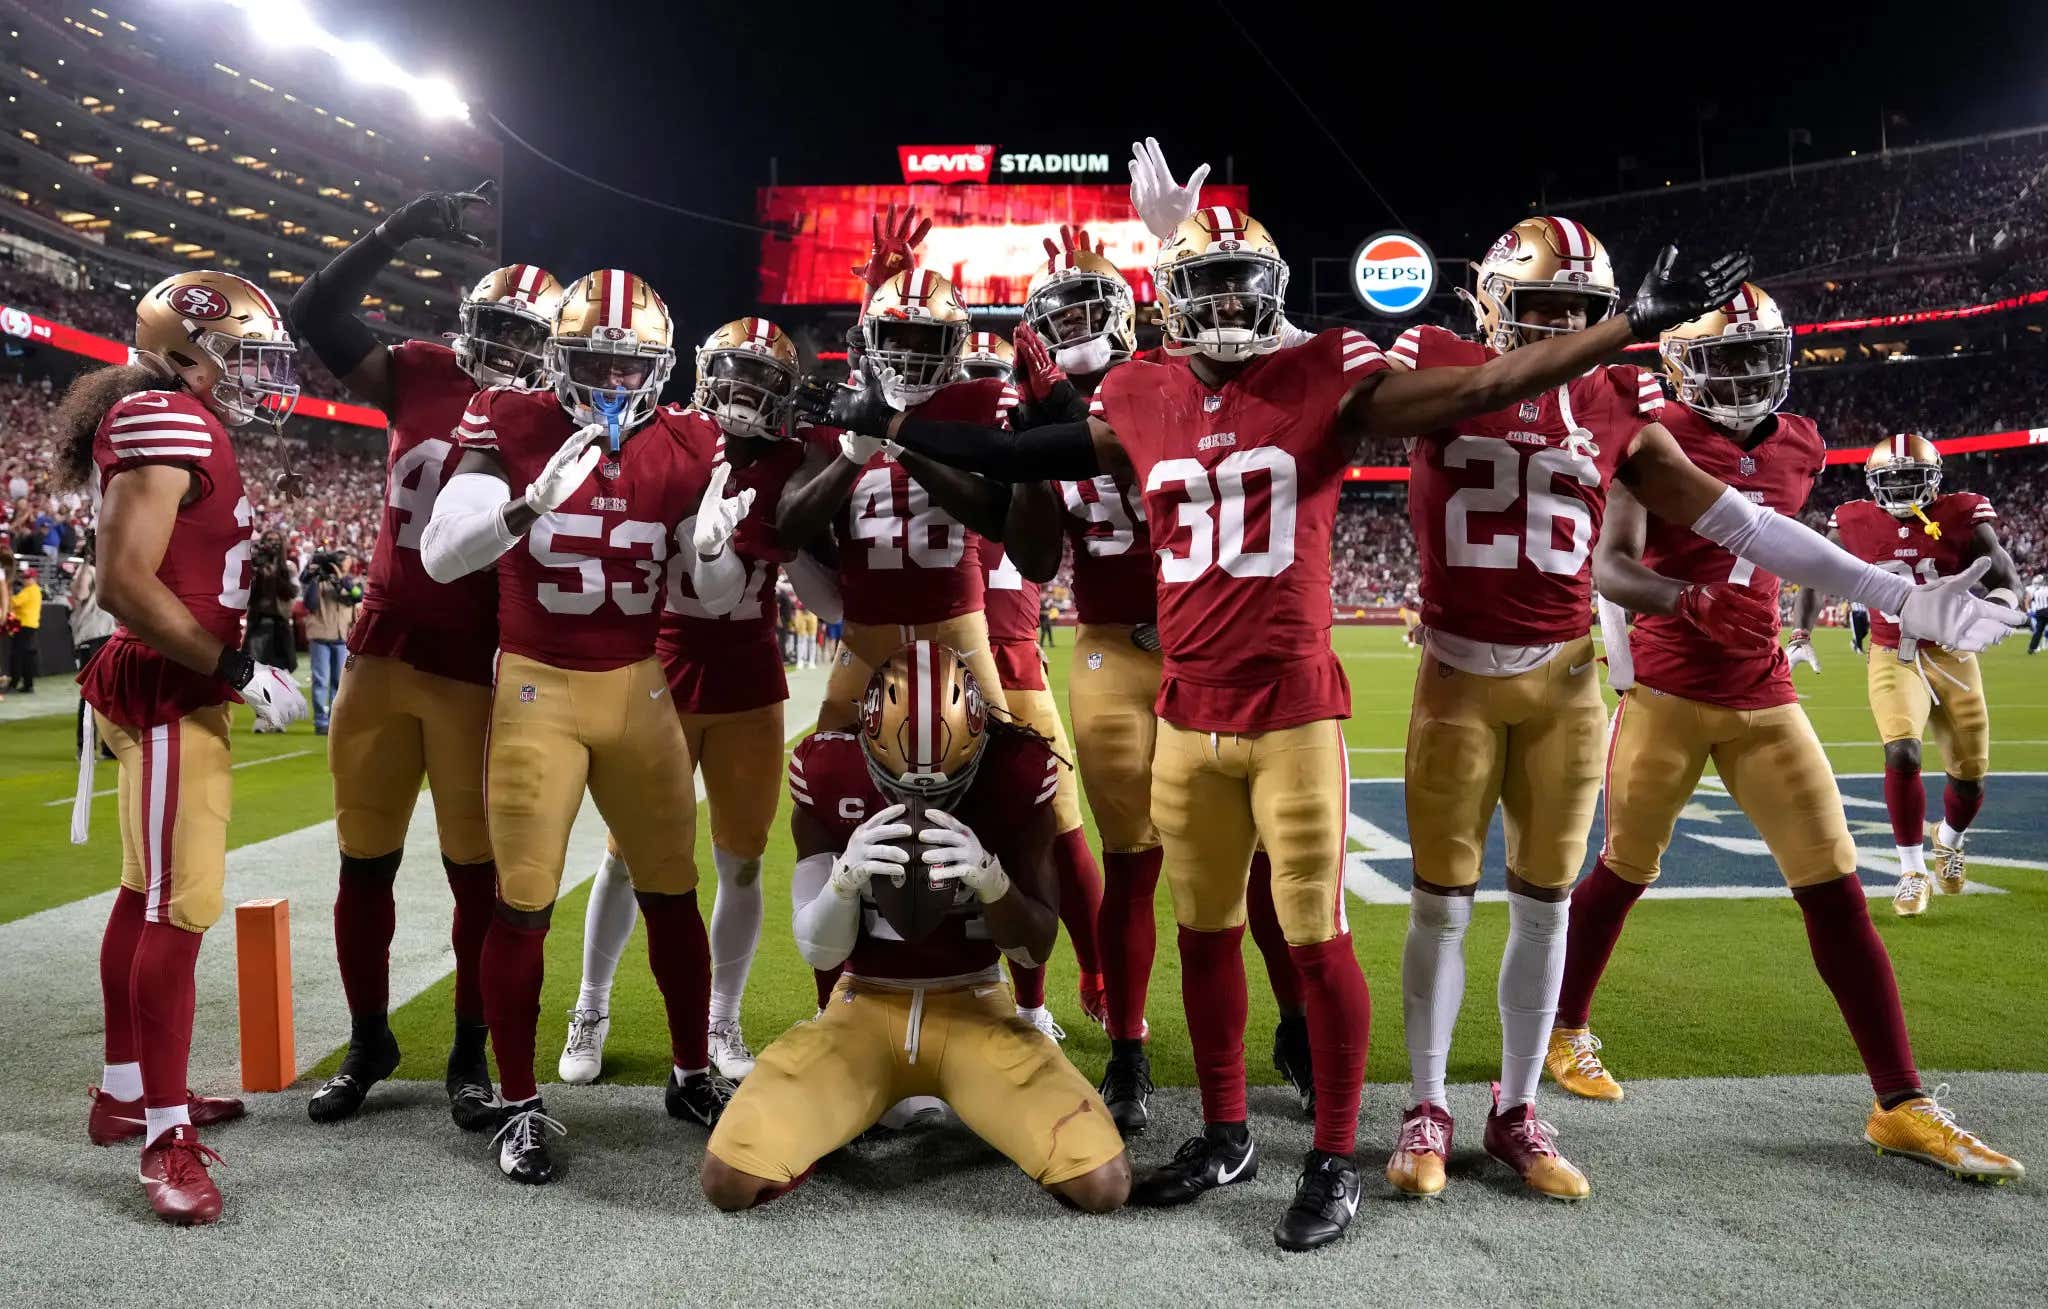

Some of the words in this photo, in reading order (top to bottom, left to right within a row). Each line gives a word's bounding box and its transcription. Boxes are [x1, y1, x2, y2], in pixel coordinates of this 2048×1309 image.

[1000, 154, 1109, 173] STADIUM
[1363, 267, 1426, 281] PEPSI
[1198, 432, 1235, 450] 49ERS
[389, 438, 453, 550] 4
[590, 496, 627, 511] 49ERS
[851, 467, 966, 569] 48
[1060, 475, 1147, 556] 9
[1146, 446, 1298, 583] 30
[1444, 435, 1601, 576] 26
[529, 511, 668, 616] 53
[838, 797, 865, 819] C
